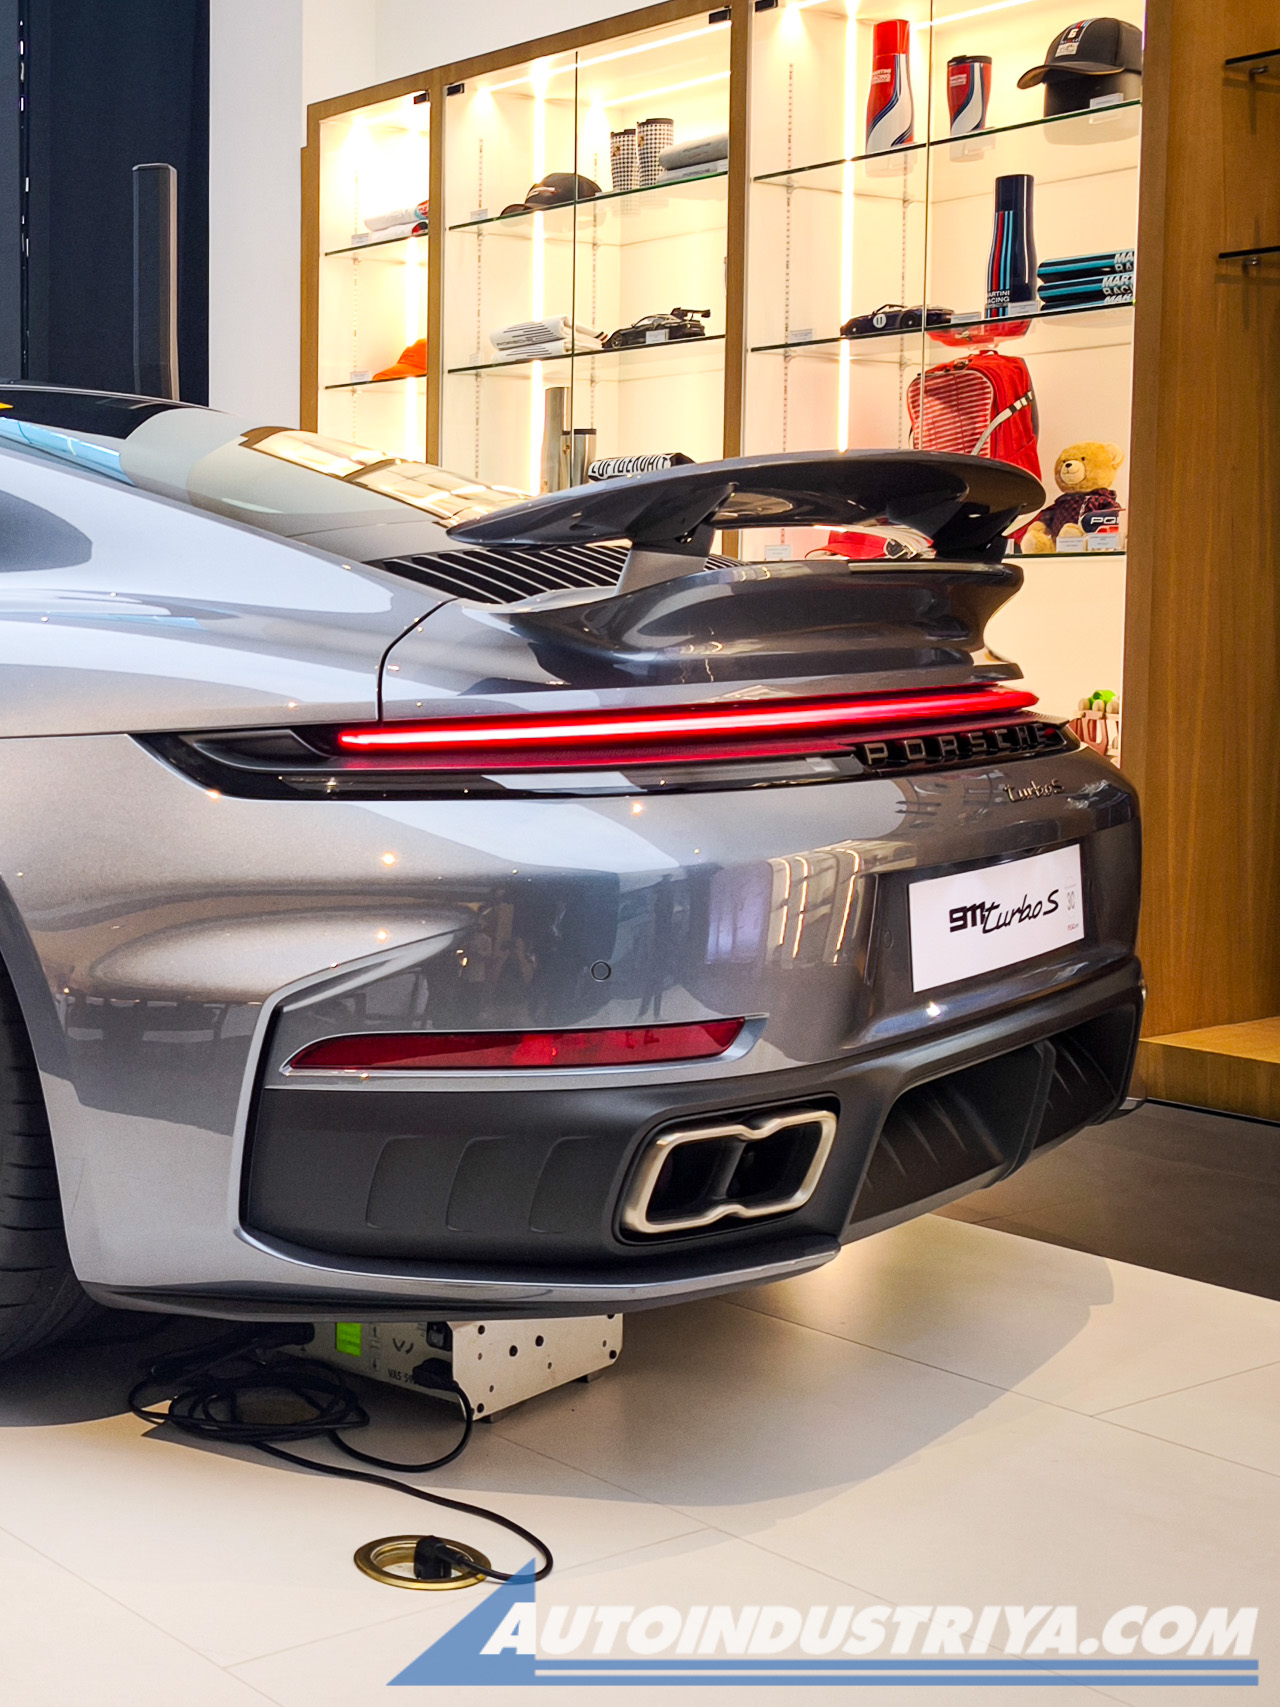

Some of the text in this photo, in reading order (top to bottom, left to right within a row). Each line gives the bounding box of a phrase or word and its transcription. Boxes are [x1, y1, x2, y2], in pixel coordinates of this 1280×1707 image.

[864, 724, 1045, 765] PORSCHE
[949, 889, 1059, 934] 911 turbo S
